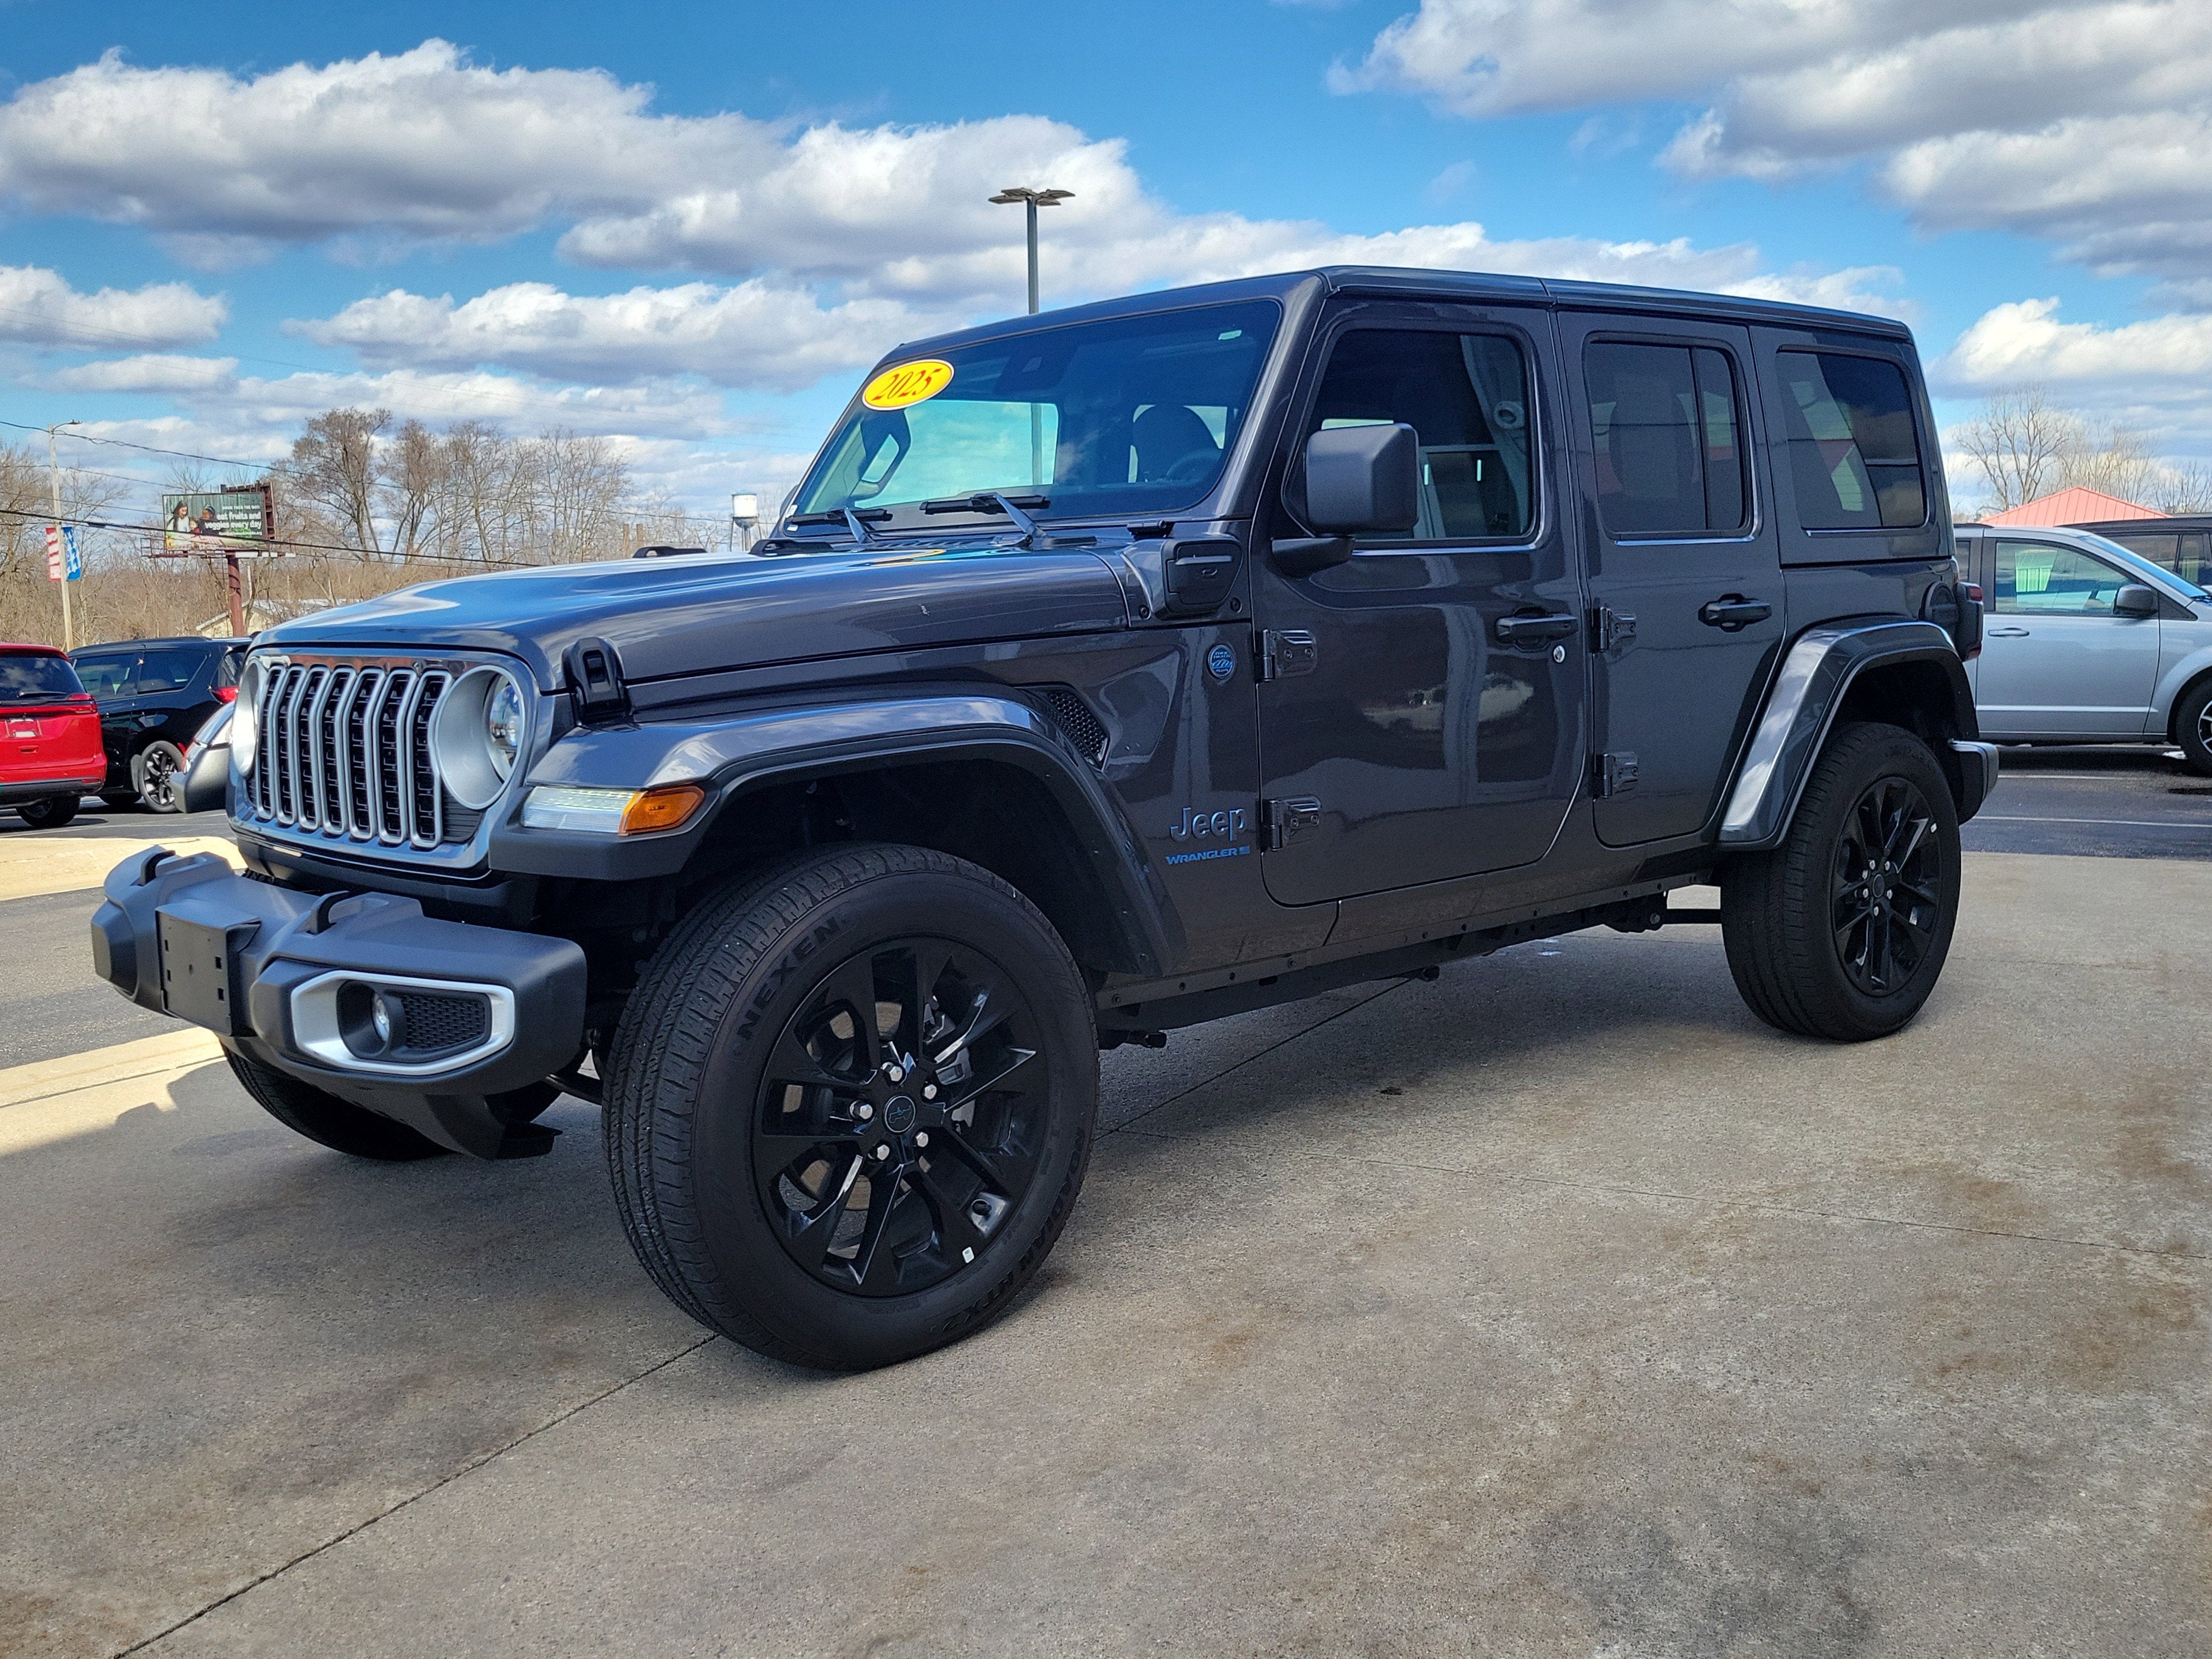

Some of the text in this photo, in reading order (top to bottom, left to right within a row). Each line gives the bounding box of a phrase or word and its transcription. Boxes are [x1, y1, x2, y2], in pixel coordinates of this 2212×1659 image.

[871, 367, 943, 401] 2025
[205, 520, 262, 531] veggies every day
[216, 511, 261, 521] eat fruits and
[1170, 807, 1247, 843] Jeep
[1166, 848, 1238, 865] WRANGLER
[736, 917, 840, 1040] NEXEN
